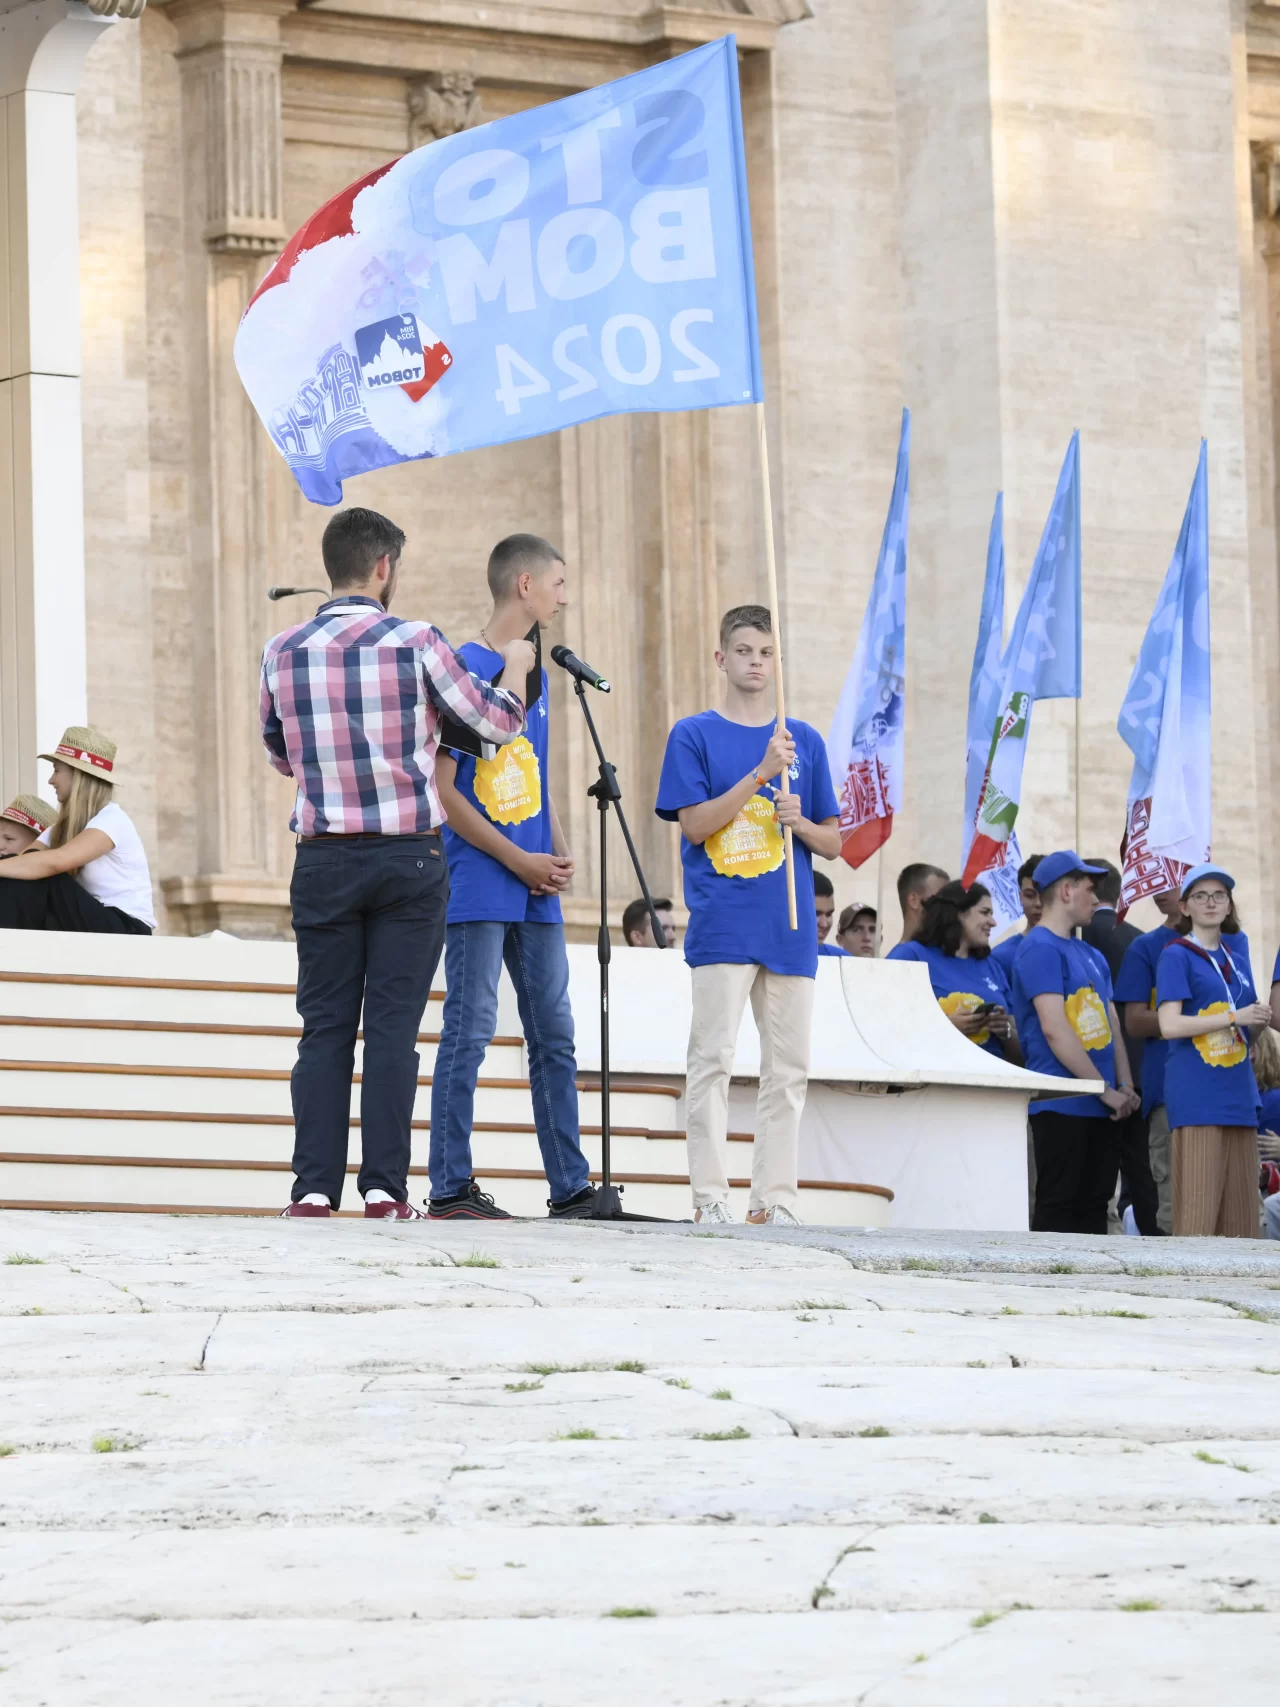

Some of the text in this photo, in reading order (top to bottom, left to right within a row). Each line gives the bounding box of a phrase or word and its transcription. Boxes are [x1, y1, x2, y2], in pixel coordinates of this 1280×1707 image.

[743, 803, 763, 811] WITH
[754, 809, 772, 817] YOU
[724, 850, 771, 865] ROME 2024
